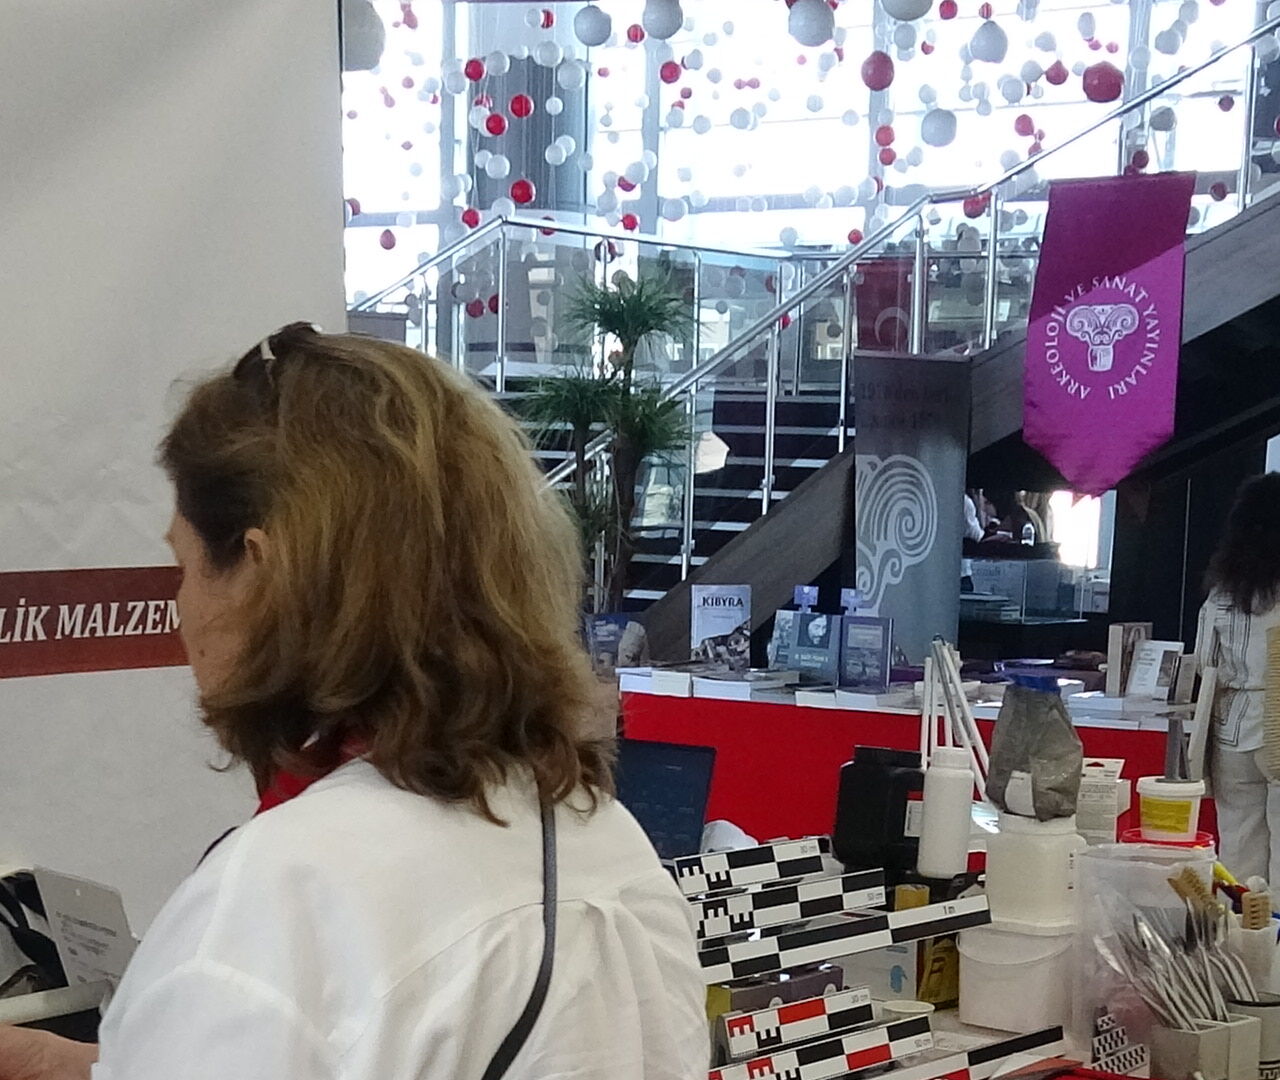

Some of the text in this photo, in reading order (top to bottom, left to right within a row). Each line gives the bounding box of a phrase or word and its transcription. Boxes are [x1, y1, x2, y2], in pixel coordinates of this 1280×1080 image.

[1065, 283, 1086, 303] VE
[1092, 274, 1149, 304] SANAT
[1108, 303, 1161, 399] YAYINLARI
